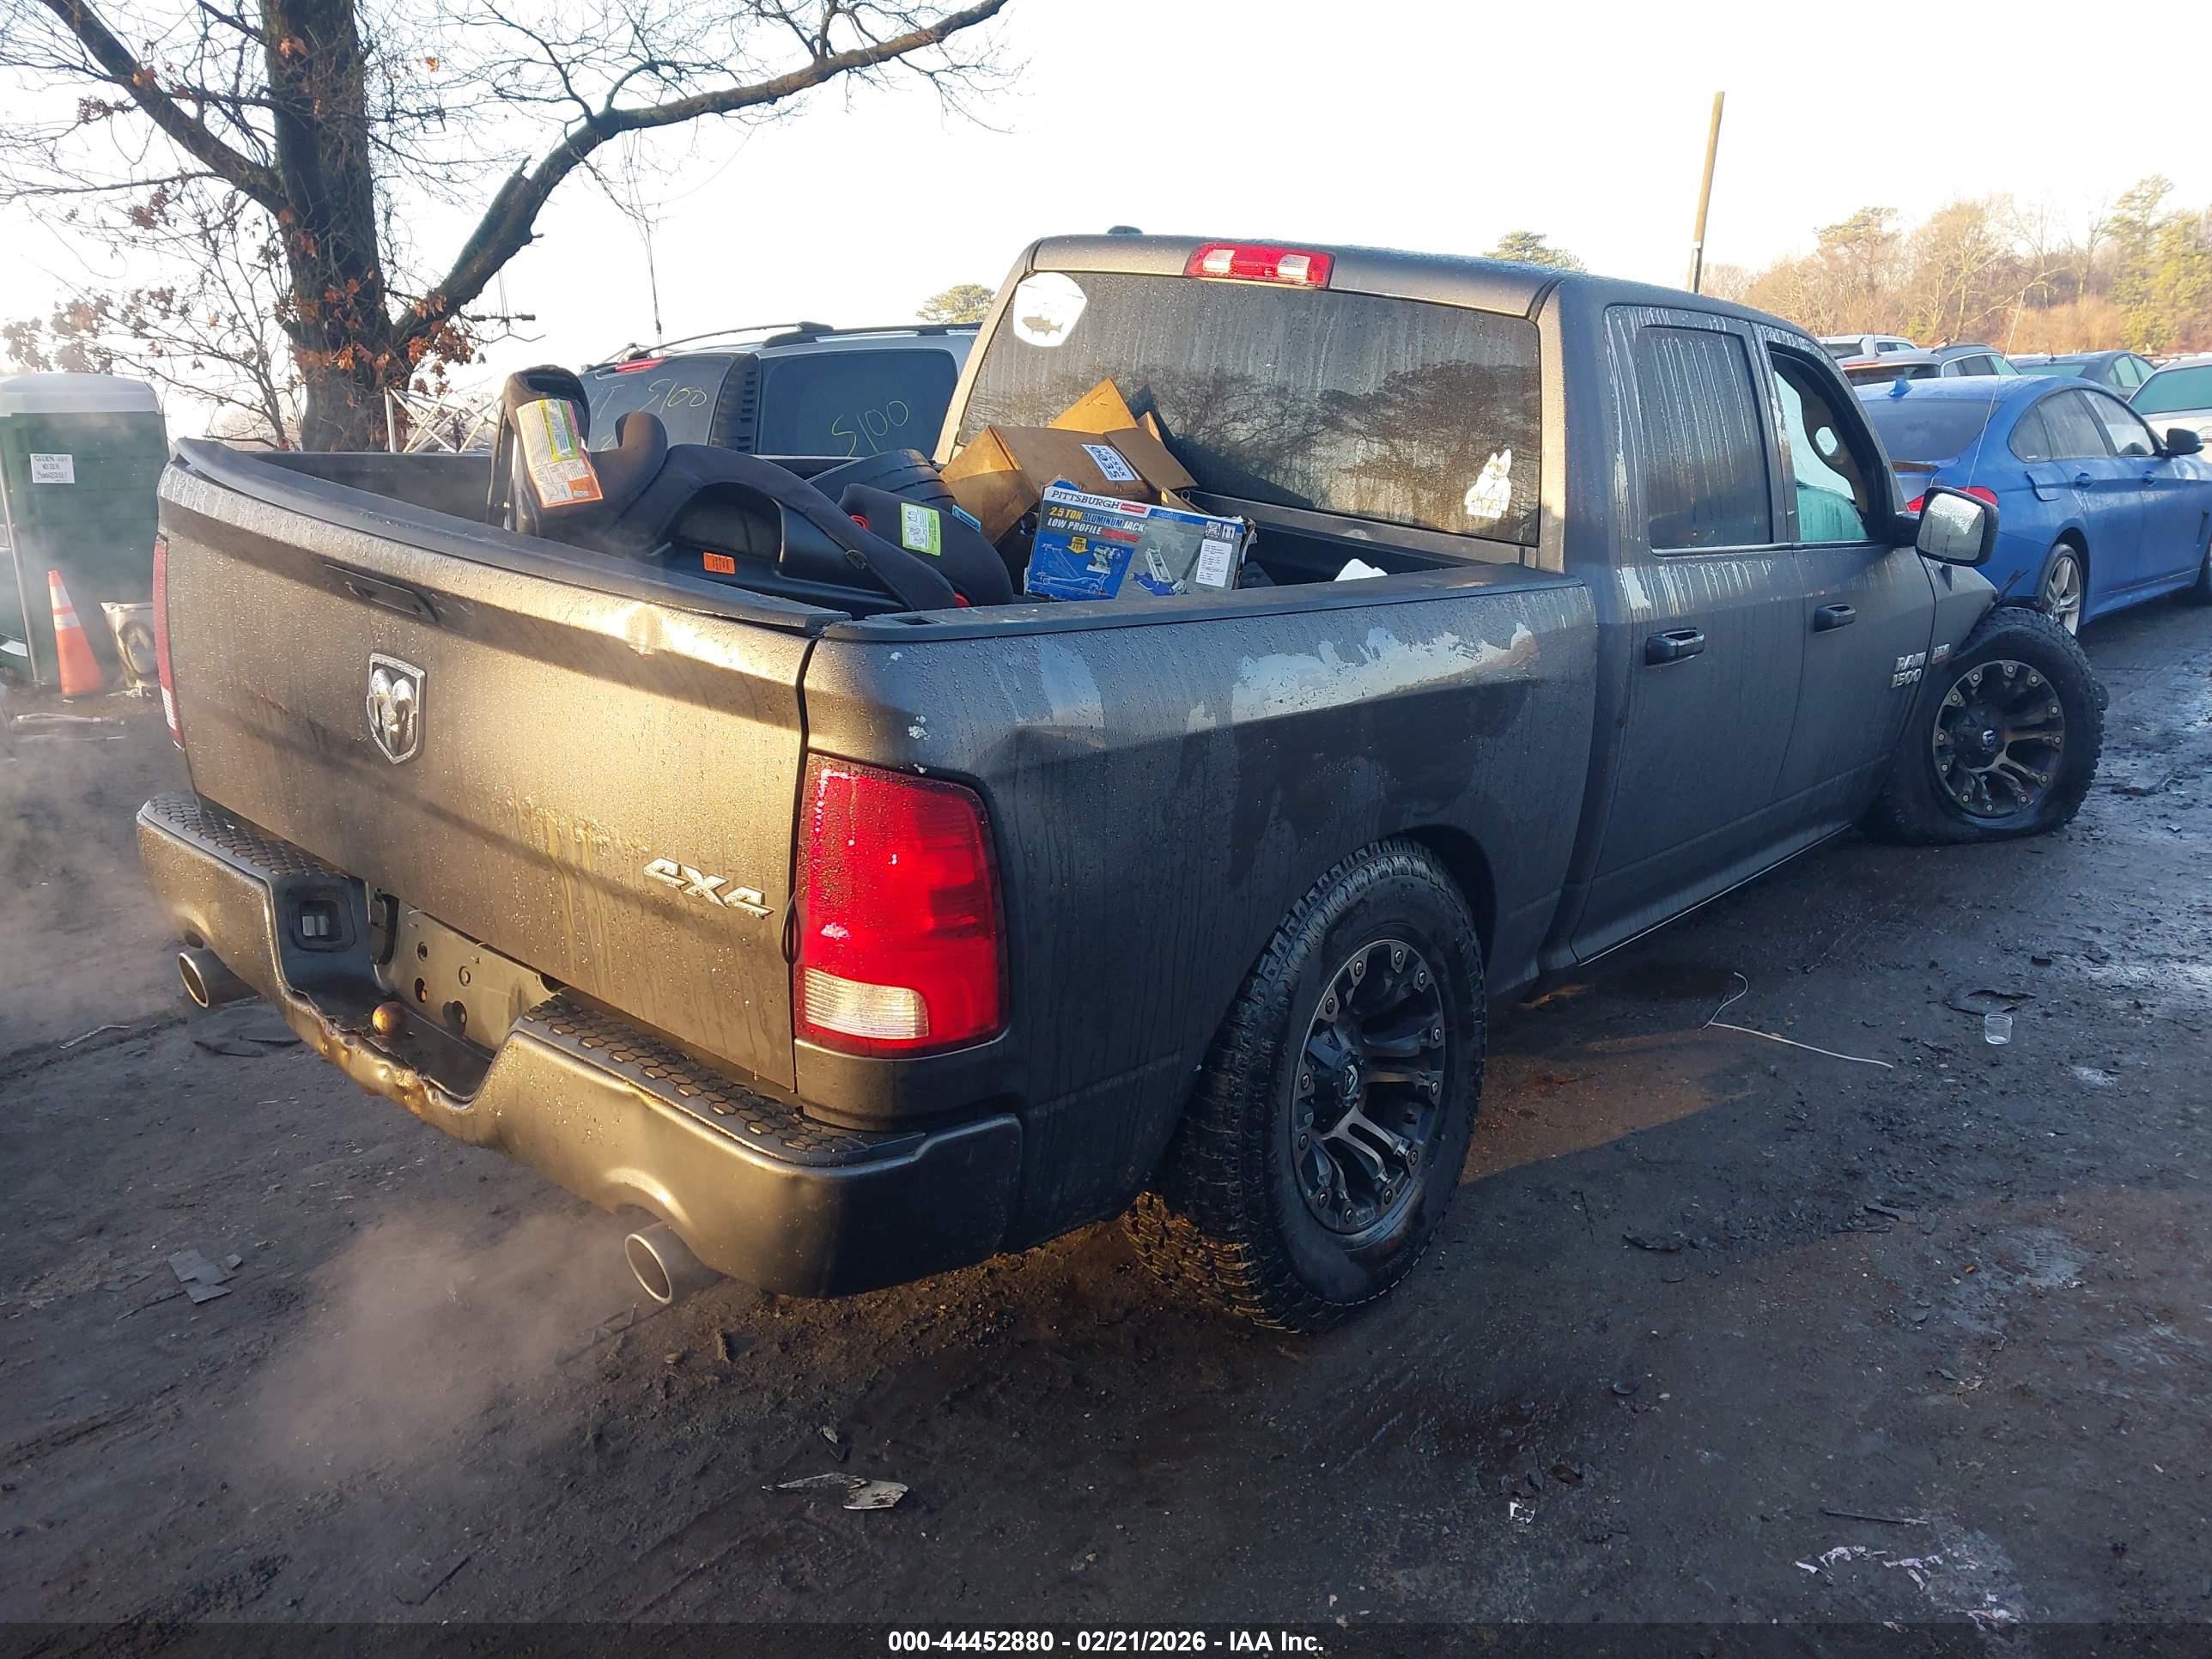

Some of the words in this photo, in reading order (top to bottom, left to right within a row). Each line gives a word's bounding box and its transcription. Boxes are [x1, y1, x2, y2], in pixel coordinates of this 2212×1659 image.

[1051, 489, 1120, 509] PITTSBURGH
[1047, 517, 1067, 529] LOW
[1067, 521, 1103, 535] PROFILE
[1065, 508, 1083, 520] TON
[1083, 512, 1124, 529] ALUMINUM
[1123, 520, 1146, 532] JACK
[1894, 651, 1927, 672] RAM
[1891, 668, 1923, 688] 1500
